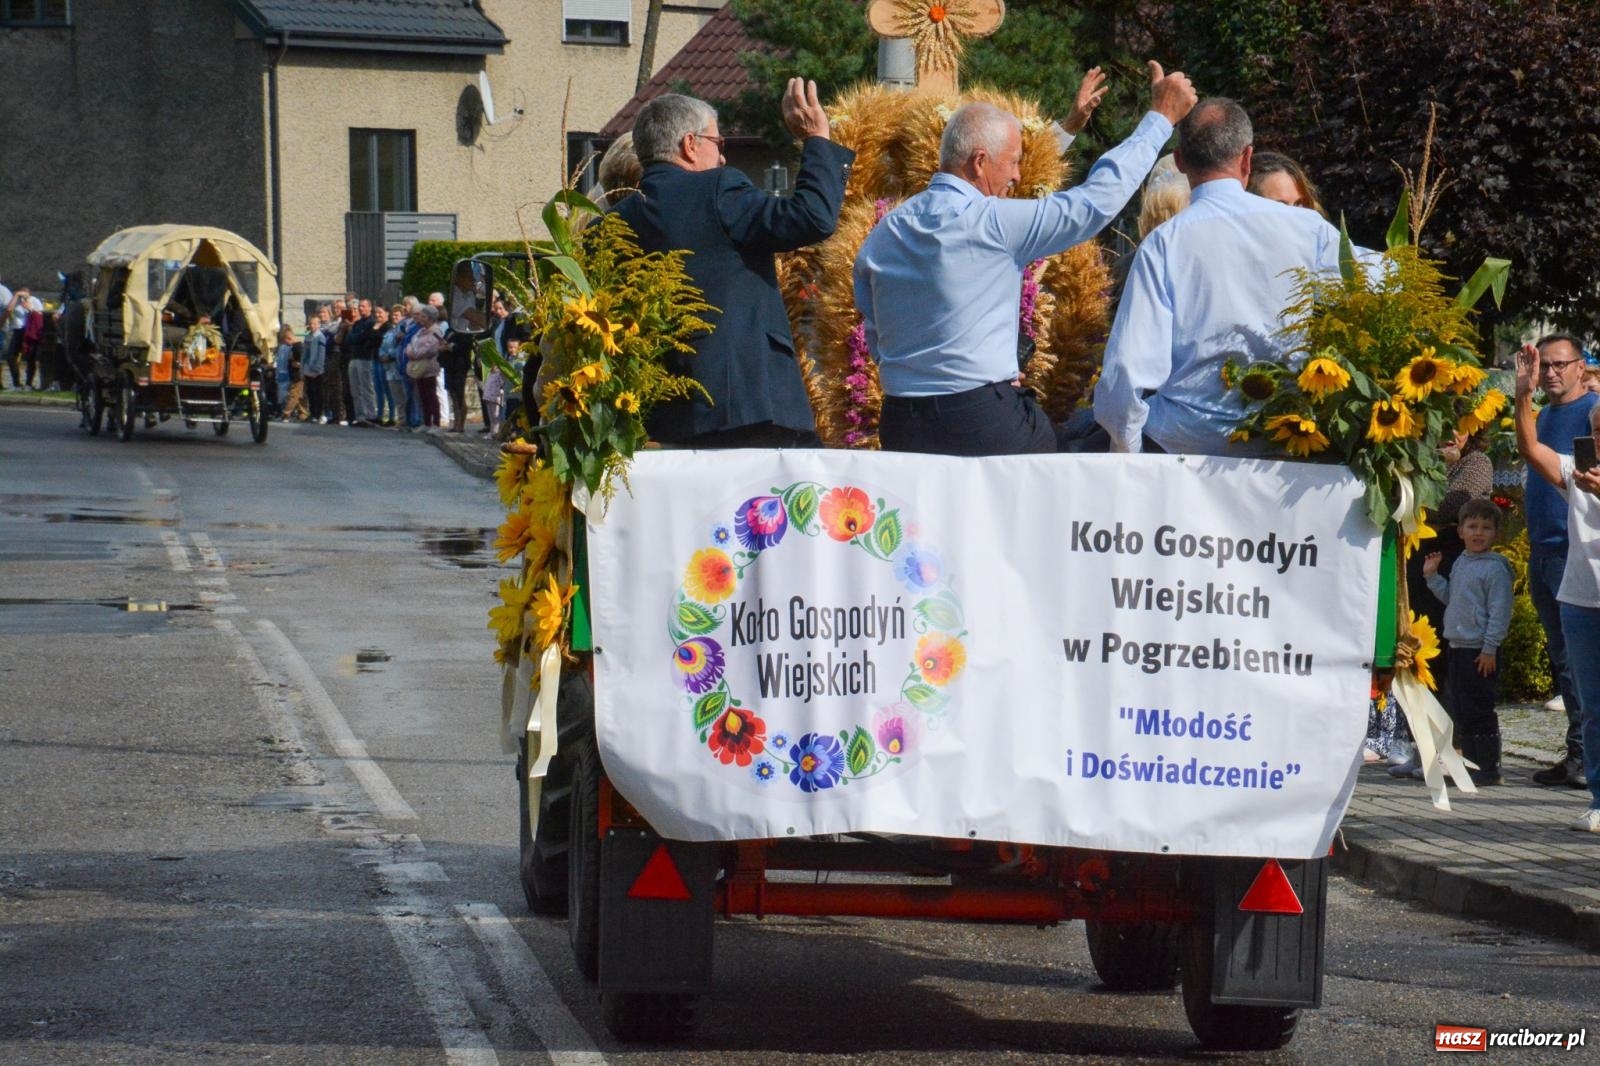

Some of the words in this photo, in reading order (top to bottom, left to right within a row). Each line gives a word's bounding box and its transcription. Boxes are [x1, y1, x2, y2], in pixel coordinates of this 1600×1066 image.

[1071, 521, 1144, 554] Koło
[1154, 525, 1318, 574] Gospodyń
[731, 598, 779, 646] Koło
[790, 594, 905, 648] Gospodyń
[1111, 577, 1270, 621] Wiejskich
[1063, 638, 1091, 662] w
[1101, 632, 1313, 676] Pogrzebieniu
[757, 650, 876, 703] Wiejskich
[1119, 706, 1252, 741] "Młodość
[1066, 749, 1073, 776] i
[1081, 752, 1301, 790] Doświadczenie”
